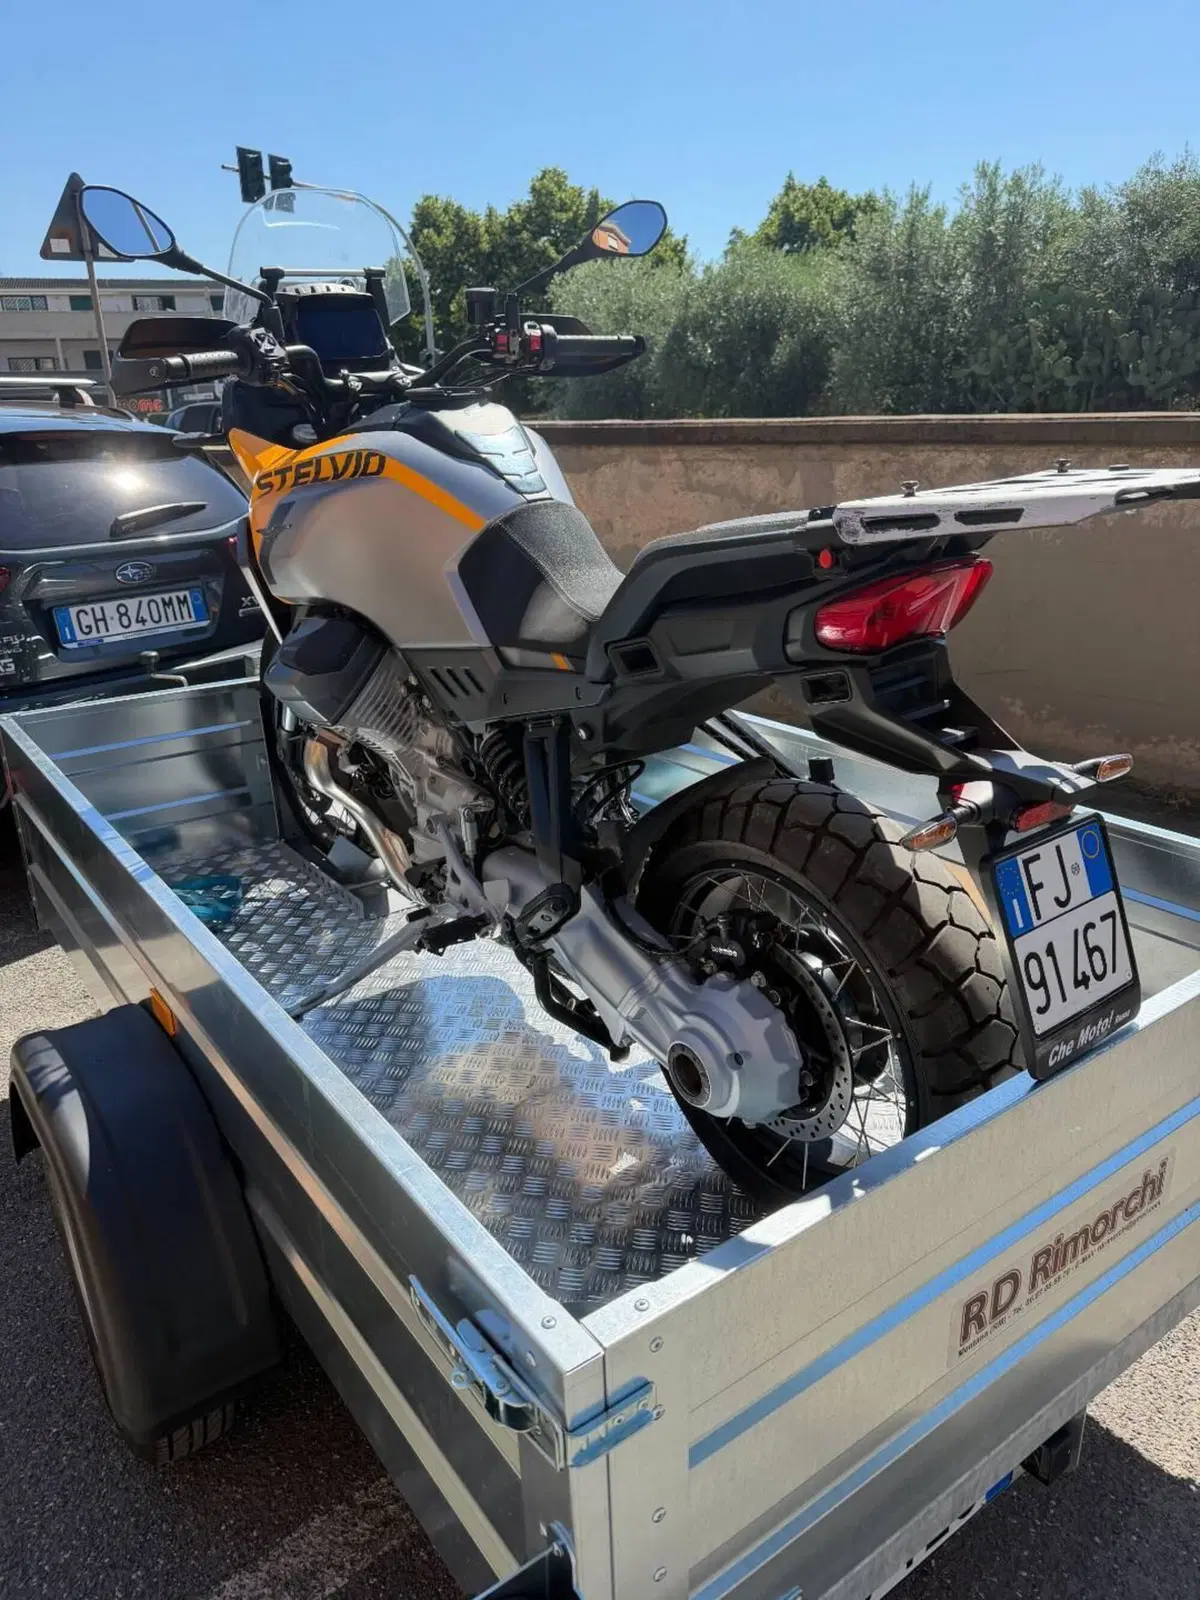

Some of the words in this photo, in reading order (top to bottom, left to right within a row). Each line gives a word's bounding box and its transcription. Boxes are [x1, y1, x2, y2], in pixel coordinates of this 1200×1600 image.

[255, 450, 387, 499] STELVIO
[75, 605, 109, 636] GH
[116, 593, 194, 628] 840MM
[1021, 844, 1072, 921] FJ
[1023, 909, 1117, 1015] 91467
[1048, 1039, 1075, 1067] Che
[1077, 1009, 1114, 1049] Moto!
[959, 1268, 1022, 1348] RD
[1027, 1156, 1169, 1294] Rimorchi
